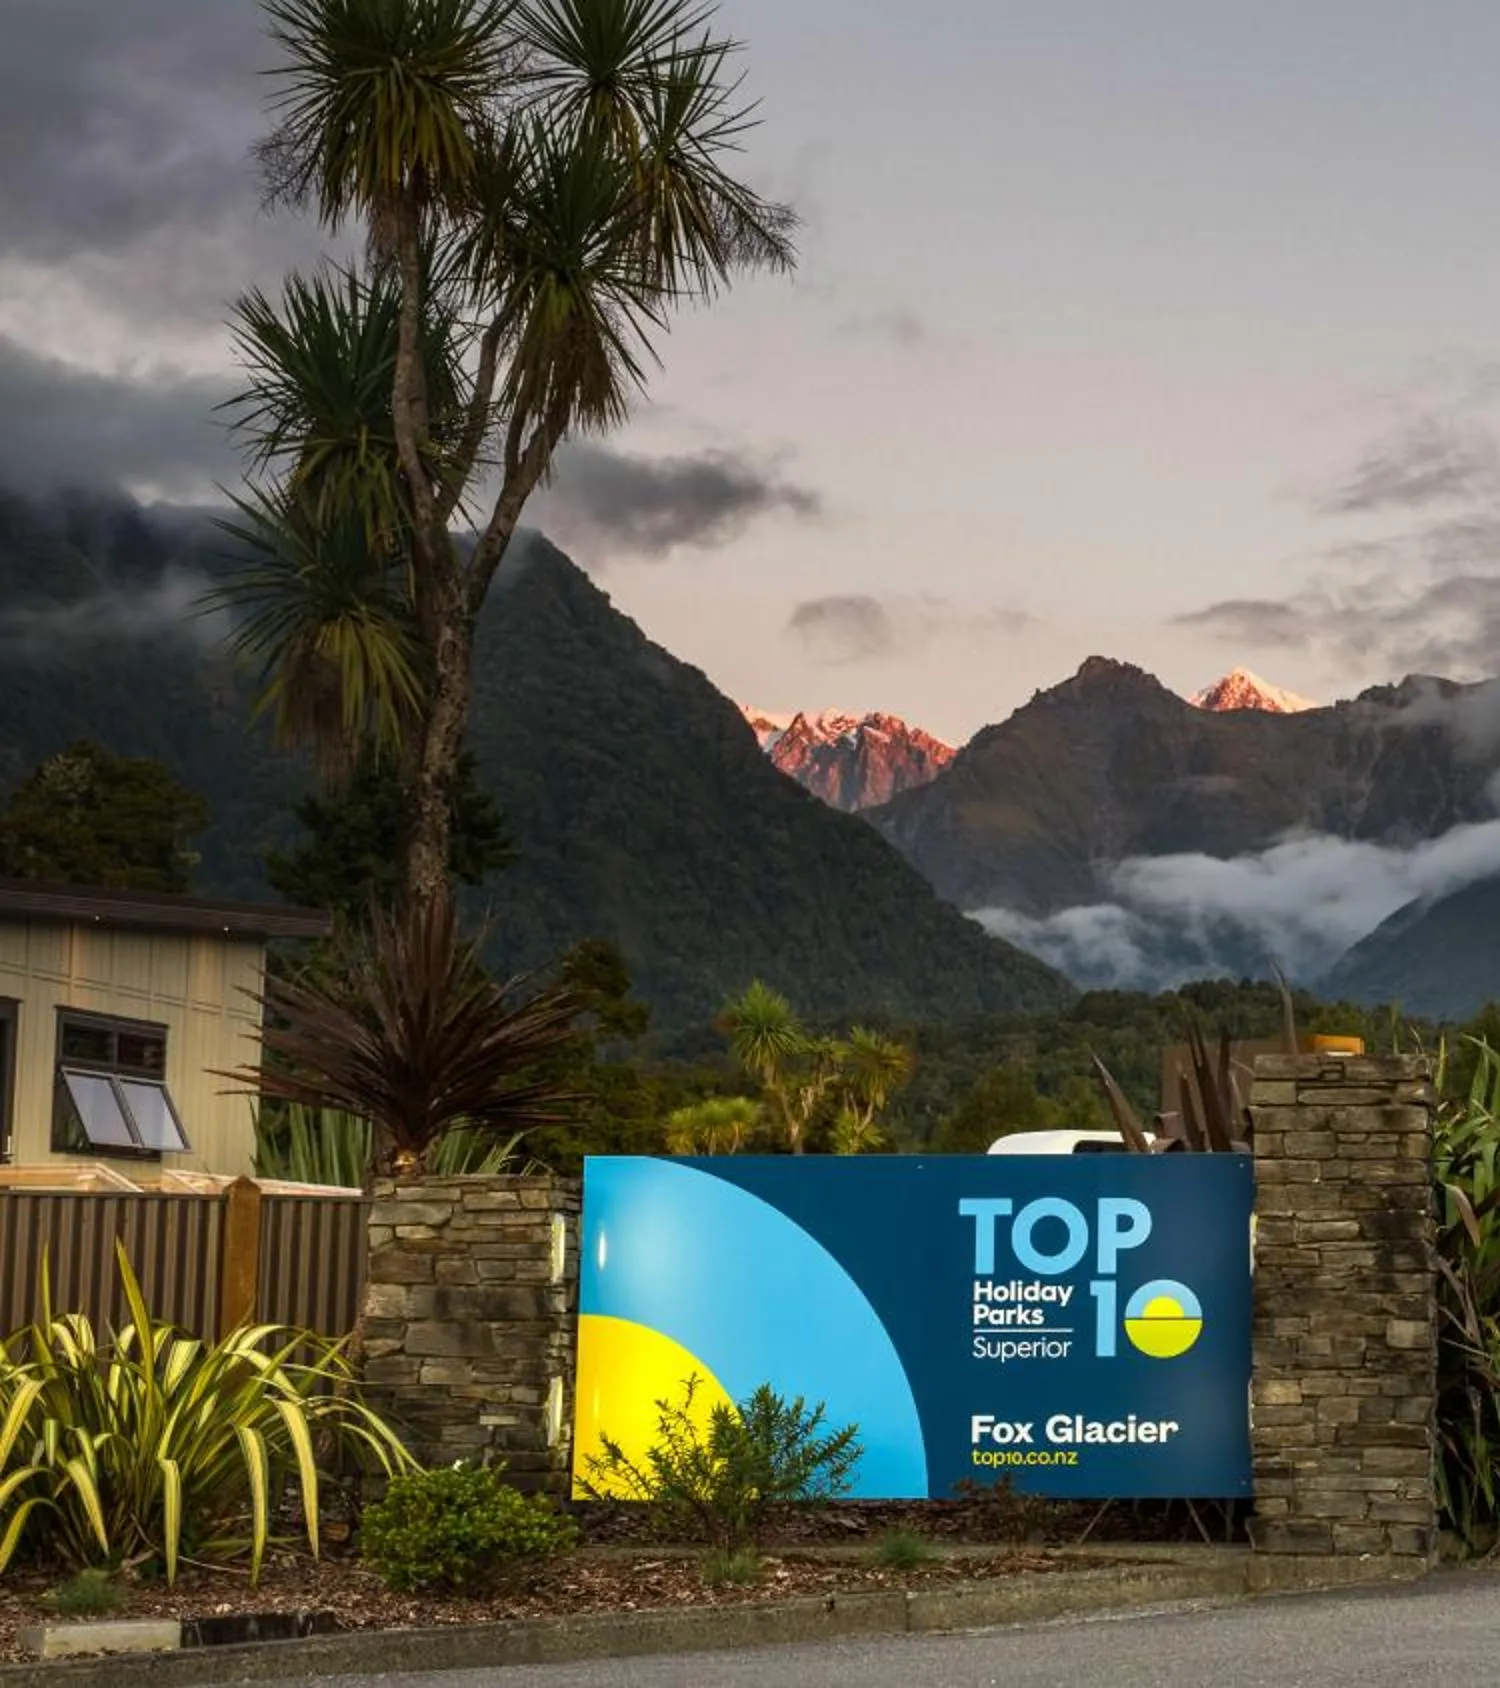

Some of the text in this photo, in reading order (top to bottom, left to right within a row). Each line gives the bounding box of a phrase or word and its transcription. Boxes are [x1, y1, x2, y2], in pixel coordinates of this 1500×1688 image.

[959, 1197, 1152, 1274] TOP
[973, 1280, 1074, 1307] Holiday
[973, 1303, 1045, 1325] Parks
[1090, 1279, 1202, 1358] 10
[972, 1336, 1072, 1363] Superior
[970, 1414, 1179, 1443] Fox Glacier
[971, 1450, 1079, 1468] top10.co.nz
